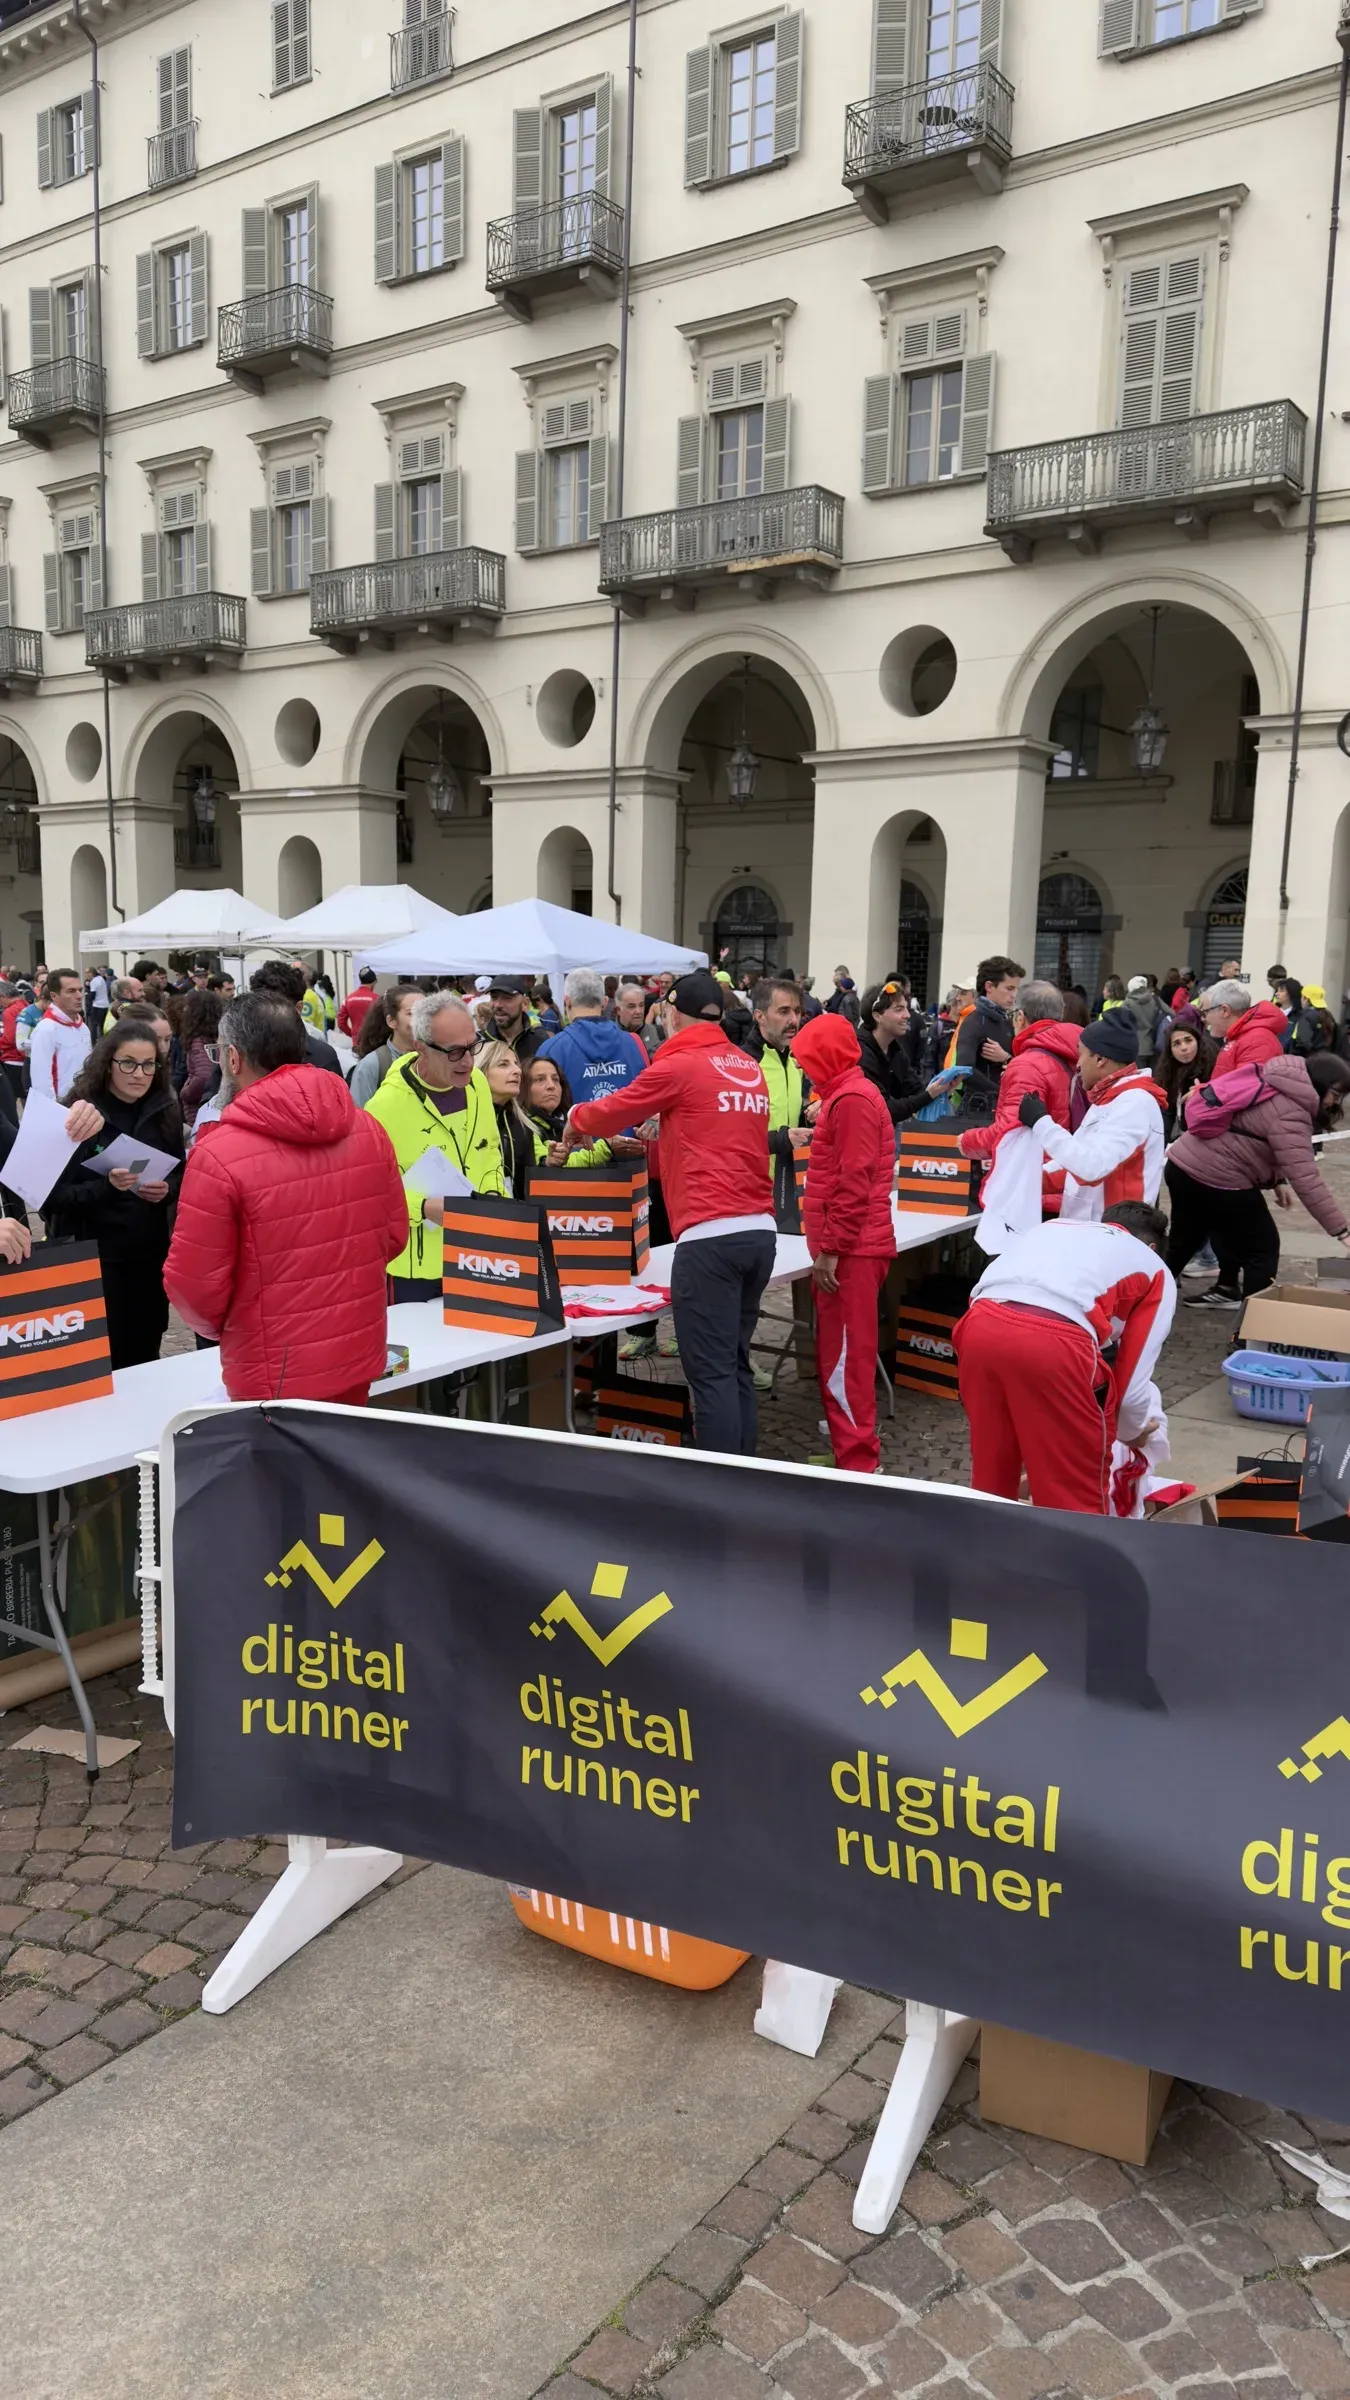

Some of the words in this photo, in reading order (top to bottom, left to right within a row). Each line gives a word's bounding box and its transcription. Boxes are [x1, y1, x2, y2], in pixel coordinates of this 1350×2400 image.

[718, 1091, 769, 1115] STAFF
[912, 1160, 959, 1176] KING
[548, 1215, 614, 1232] KING
[458, 1253, 520, 1278] KING
[0, 1310, 84, 1346] KING
[909, 1335, 954, 1357] KING
[611, 1425, 665, 1445] KING
[4, 1526, 12, 1541] 180
[242, 1624, 405, 1694] digital
[243, 1699, 408, 1752] runner
[521, 1675, 693, 1761] digital
[521, 1747, 700, 1823] runner
[831, 1752, 1060, 1853] digital
[838, 1828, 1062, 1918] runner
